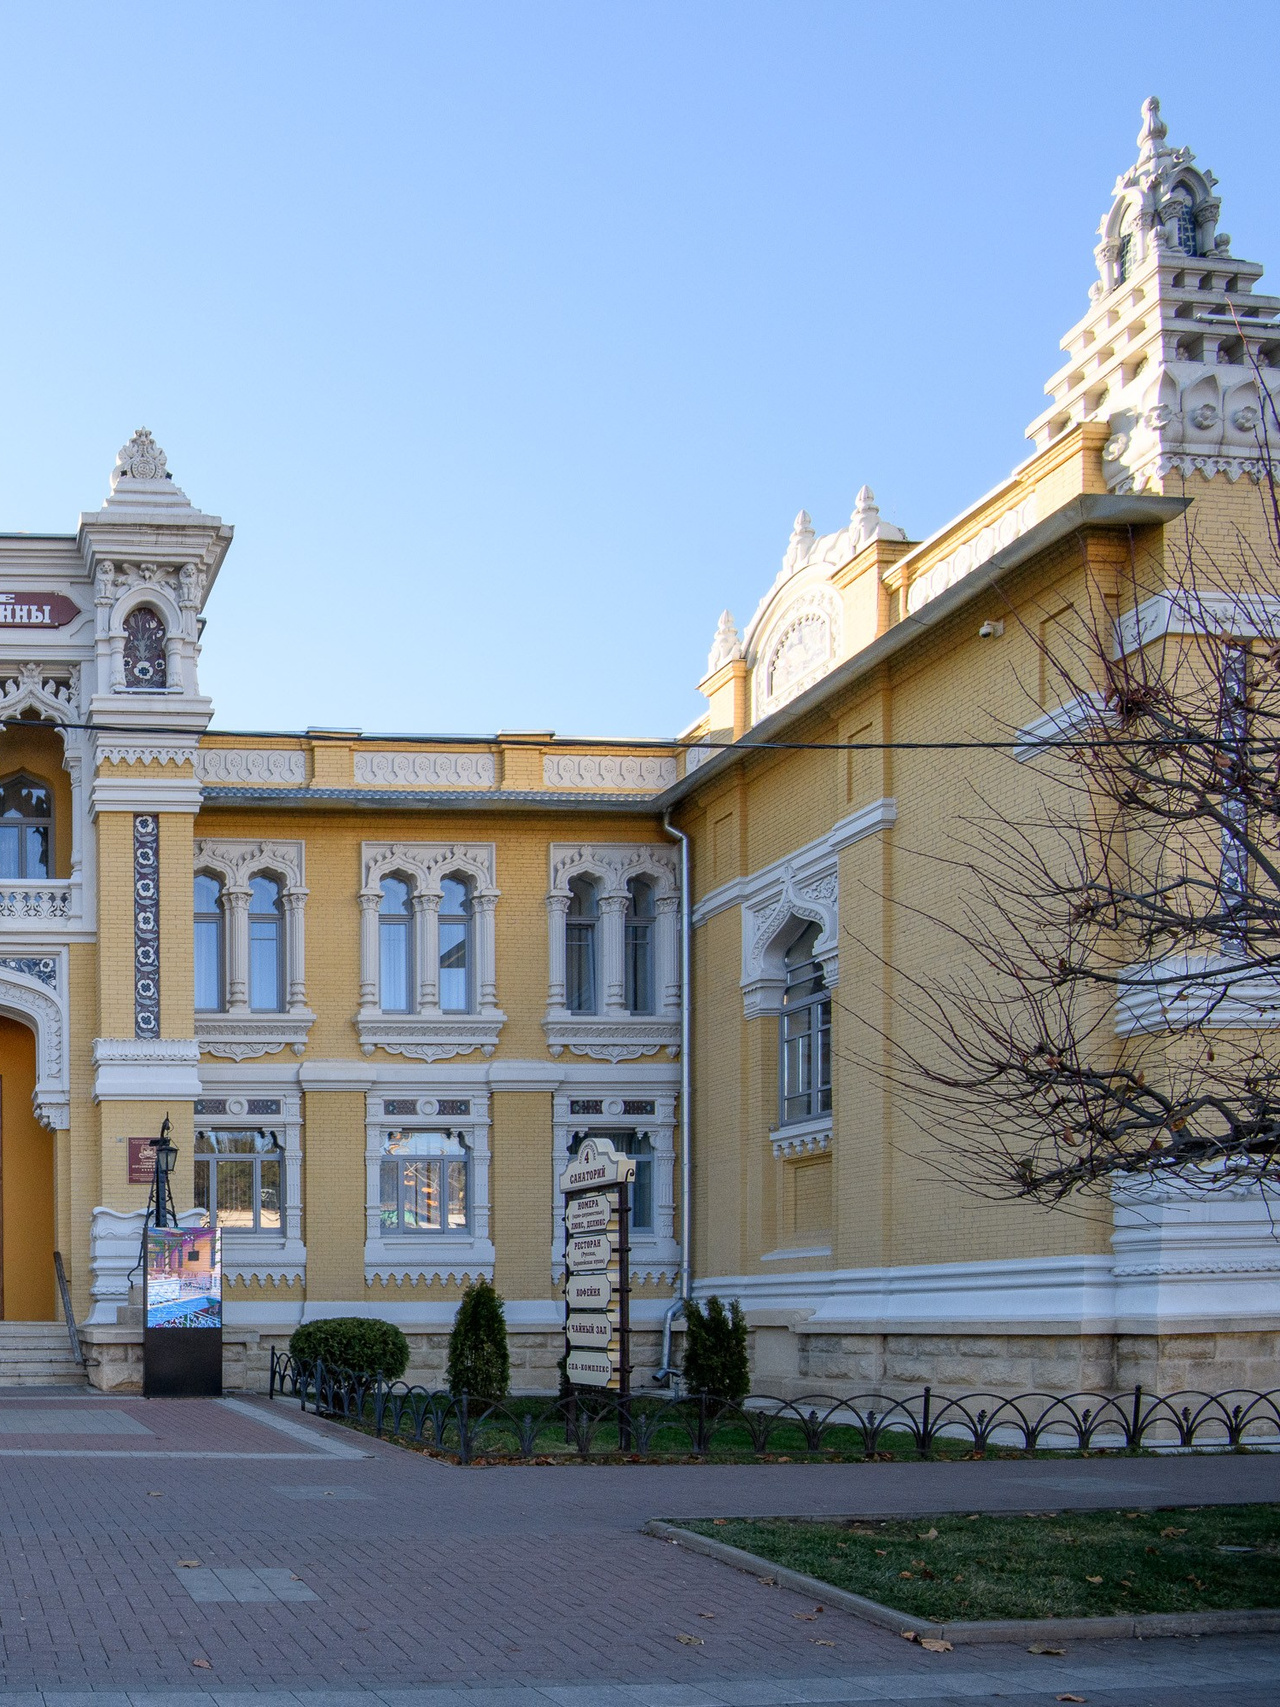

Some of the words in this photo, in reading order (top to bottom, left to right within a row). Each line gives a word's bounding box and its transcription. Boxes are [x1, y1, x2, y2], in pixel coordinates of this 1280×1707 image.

[584, 1150, 590, 1164] 4
[570, 1165, 606, 1184] САНАТОРИЙ
[574, 1238, 601, 1251] РЕСТОРАН
[576, 1286, 601, 1297] КОФЕЙНЯ
[571, 1322, 595, 1335] ЧАЙНЫЙ
[595, 1325, 607, 1336] ЗАЛ
[568, 1362, 609, 1374] СПА-КОМПЛЕКС
